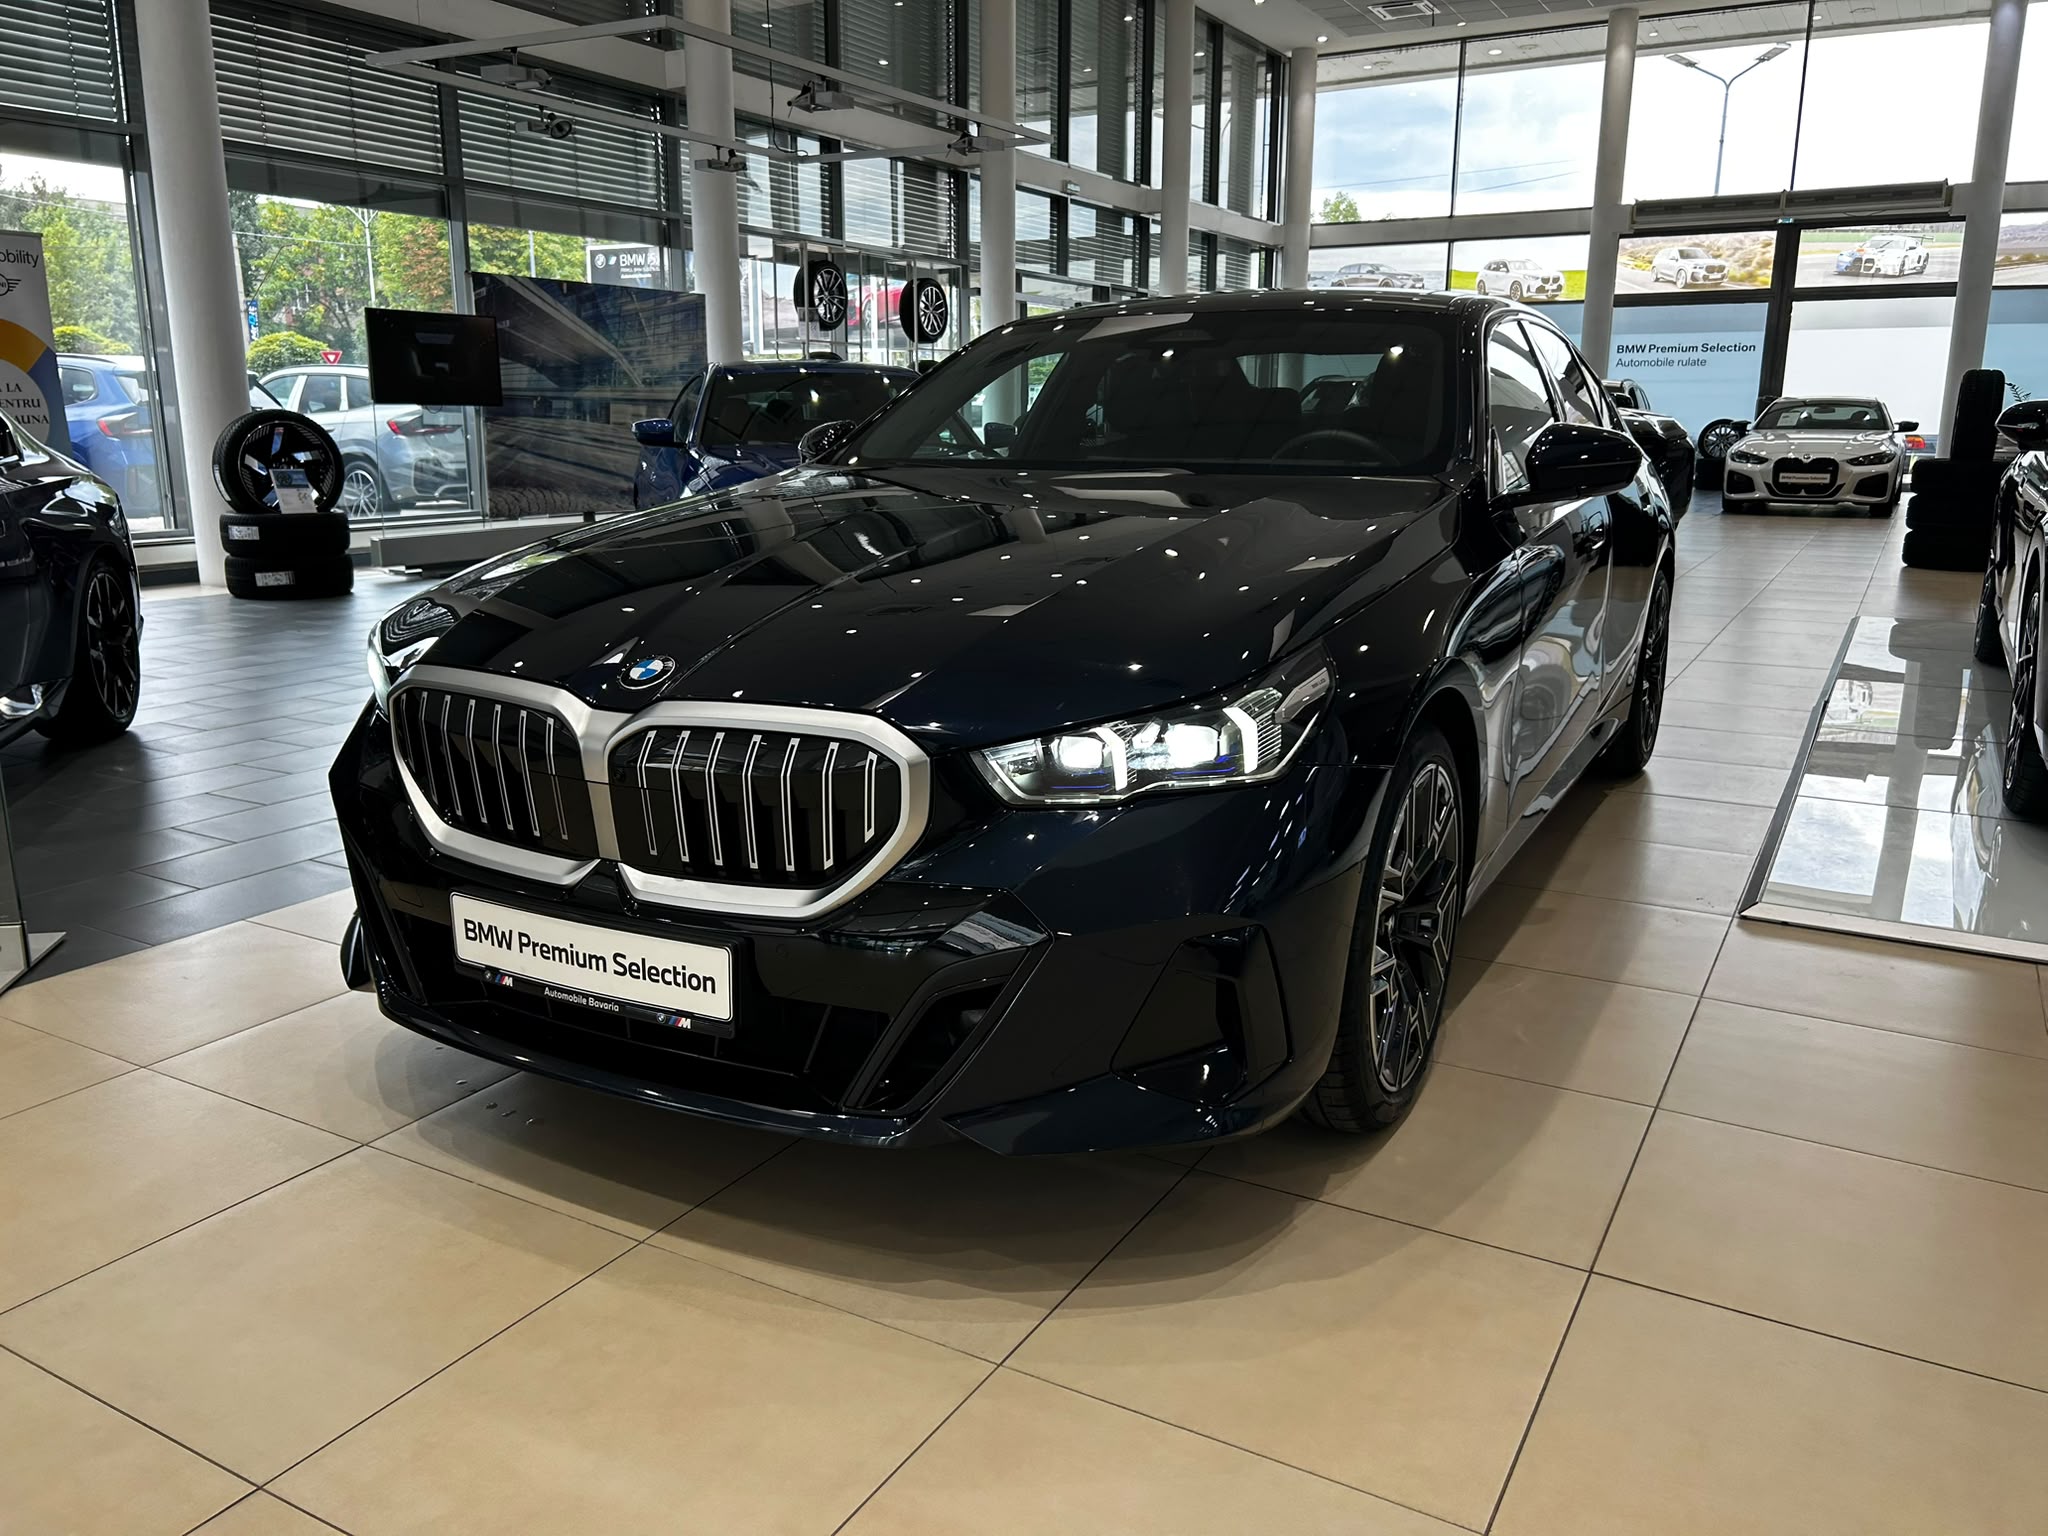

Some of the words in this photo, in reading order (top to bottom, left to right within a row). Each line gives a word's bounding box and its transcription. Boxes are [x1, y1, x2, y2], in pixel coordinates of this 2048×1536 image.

[620, 253, 645, 267] BMW
[1616, 344, 1647, 354] BMW
[1648, 343, 1699, 353] Premium
[1701, 342, 1756, 353] Selection
[1615, 357, 1675, 367] Automobile
[1677, 357, 1707, 367] rulate
[6, 383, 22, 393] LA
[463, 918, 513, 950] BMW
[518, 932, 607, 973] Premium
[612, 953, 716, 994] Selection
[543, 986, 587, 1005] Automobile
[588, 997, 620, 1012] Bavaria
